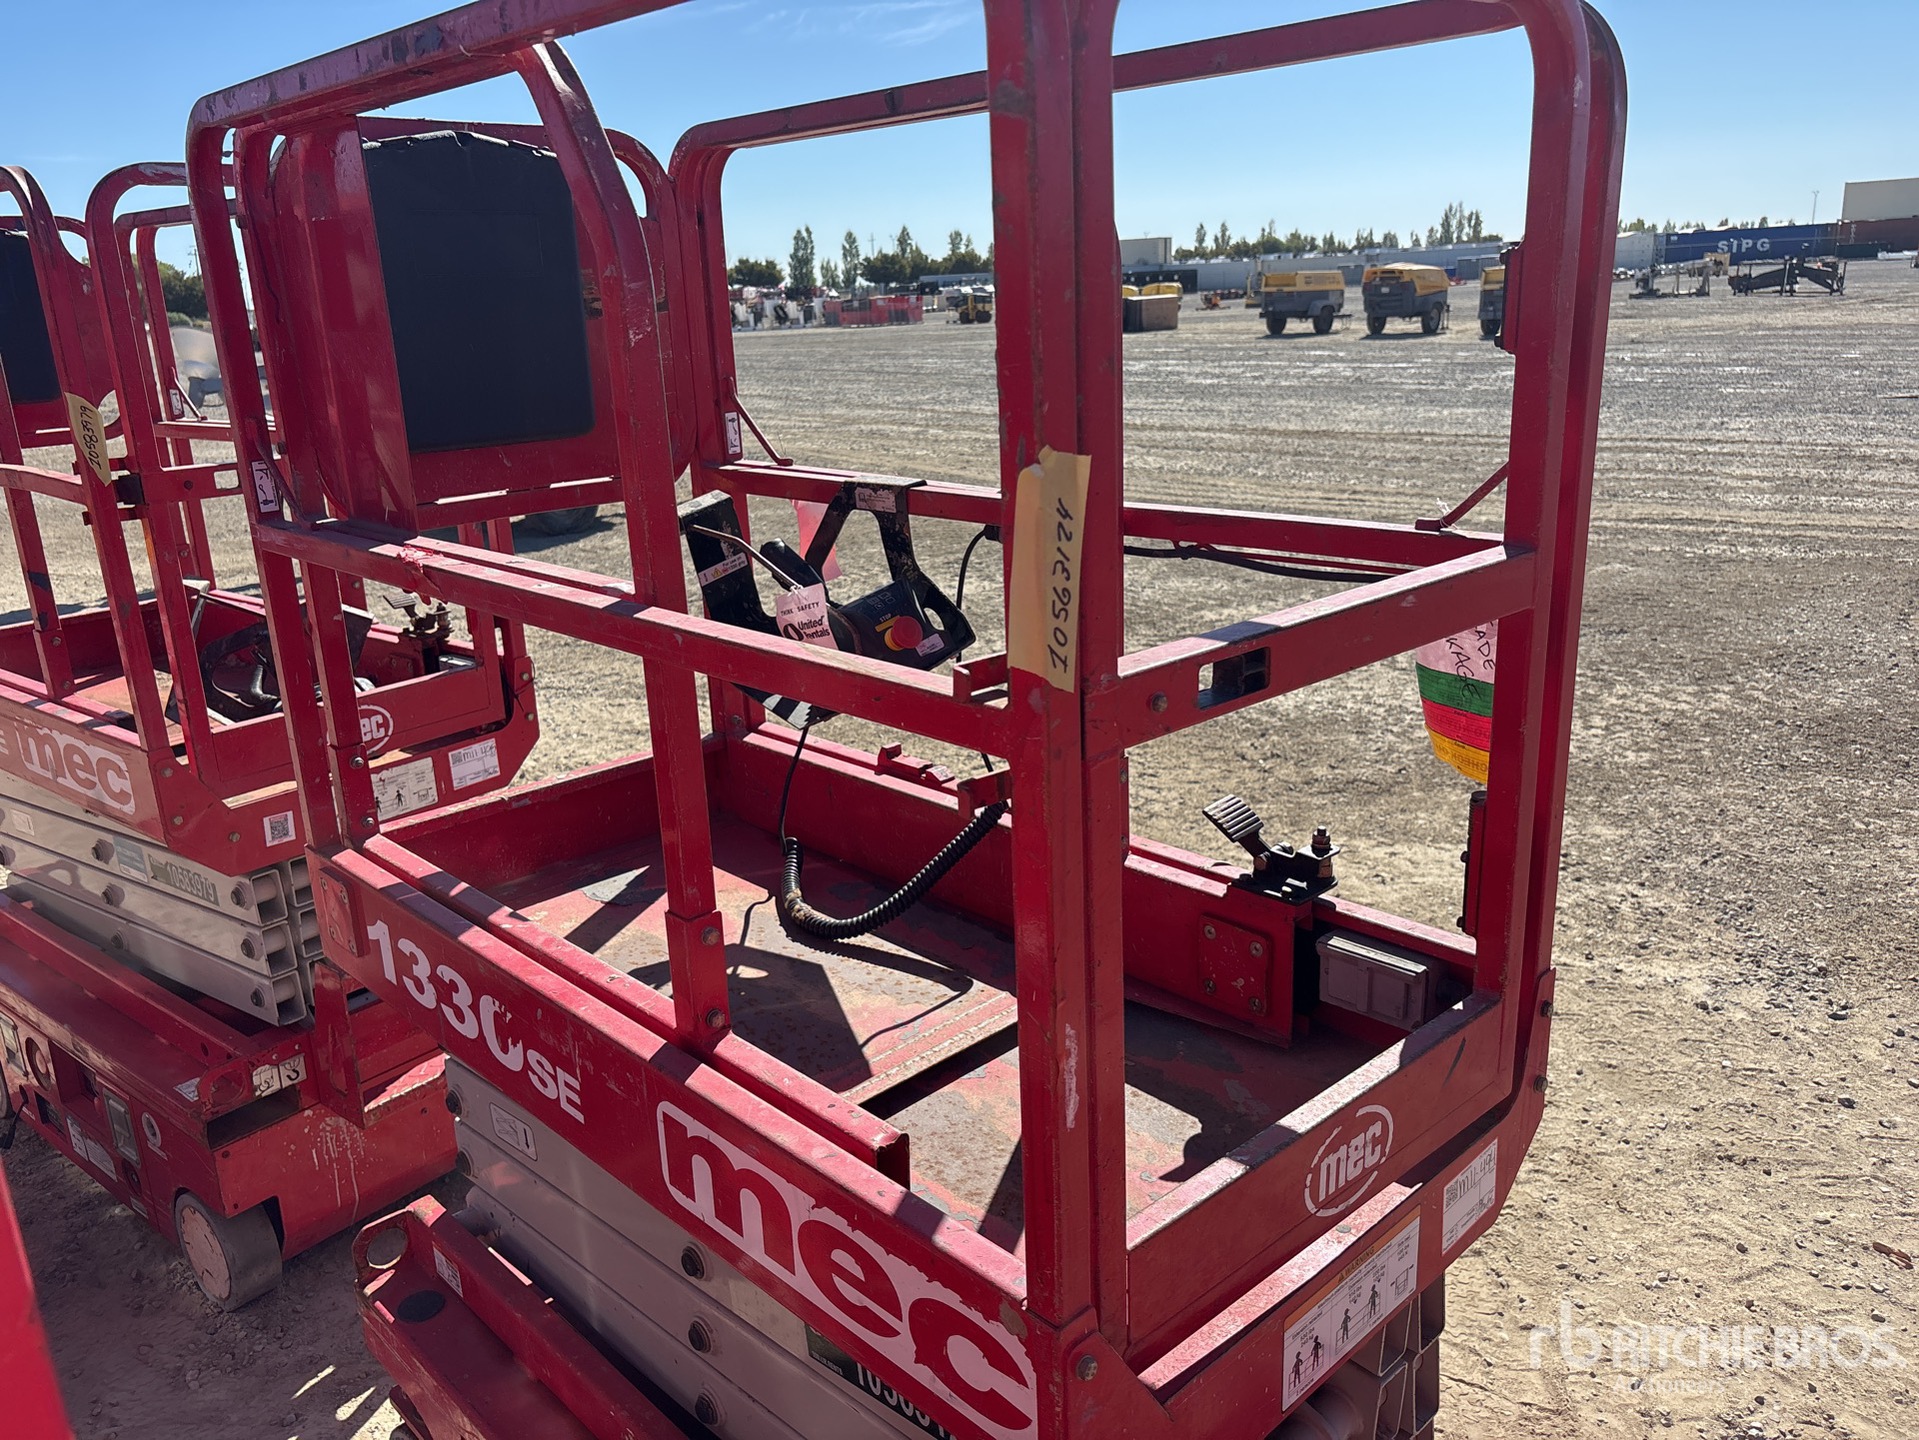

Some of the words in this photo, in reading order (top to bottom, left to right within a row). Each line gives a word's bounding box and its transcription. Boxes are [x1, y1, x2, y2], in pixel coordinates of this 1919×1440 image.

[1717, 238, 1771, 254] SIPG
[797, 601, 820, 612] SAFETY
[1047, 497, 1074, 674] 10563124
[797, 615, 825, 631] United
[1445, 637, 1482, 701] KAGE
[1475, 625, 1496, 671] ADE
[360, 714, 386, 743] ec
[1319, 1121, 1382, 1203] mec
[659, 1103, 1036, 1440] mec
